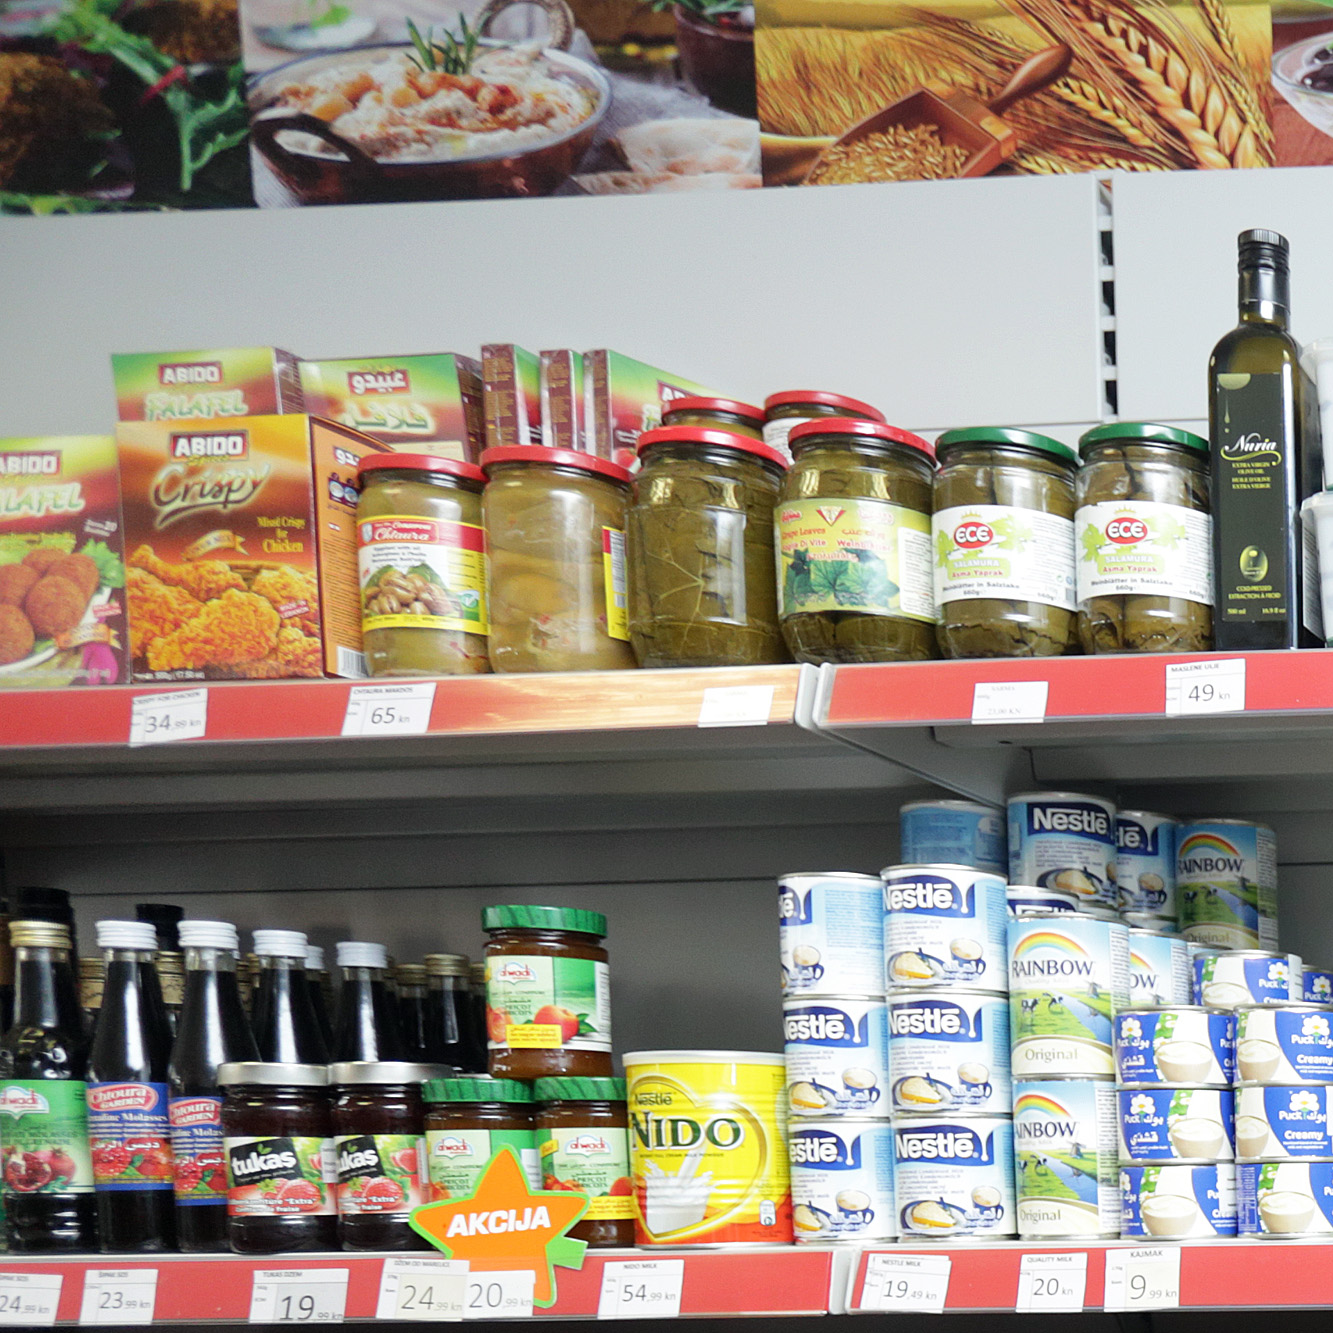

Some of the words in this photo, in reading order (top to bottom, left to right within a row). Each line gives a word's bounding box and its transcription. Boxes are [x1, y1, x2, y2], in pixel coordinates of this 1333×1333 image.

[162, 365, 220, 383] ABIDO
[175, 434, 243, 456] ABIDO
[1223, 433, 1277, 455] Nuria
[152, 463, 270, 511] Crispy
[1107, 521, 1144, 538] ECE
[1105, 555, 1154, 564] SALAMURA
[1188, 684, 1214, 702] 49
[1218, 691, 1230, 701] kn
[372, 707, 395, 725] 65
[399, 715, 410, 724] kn
[1033, 808, 1107, 835] Nestlé
[1012, 960, 1093, 977] RAINBOW
[1025, 1047, 1079, 1062] Original
[1296, 1054, 1333, 1067] Creamy
[632, 1110, 742, 1150] NIDO
[895, 1130, 974, 1158] Nestlé
[446, 1208, 551, 1238] AKCIJA
[1130, 1250, 1163, 1258] KAJMAK
[1033, 1278, 1059, 1296] 20
[1061, 1286, 1073, 1296] kn
